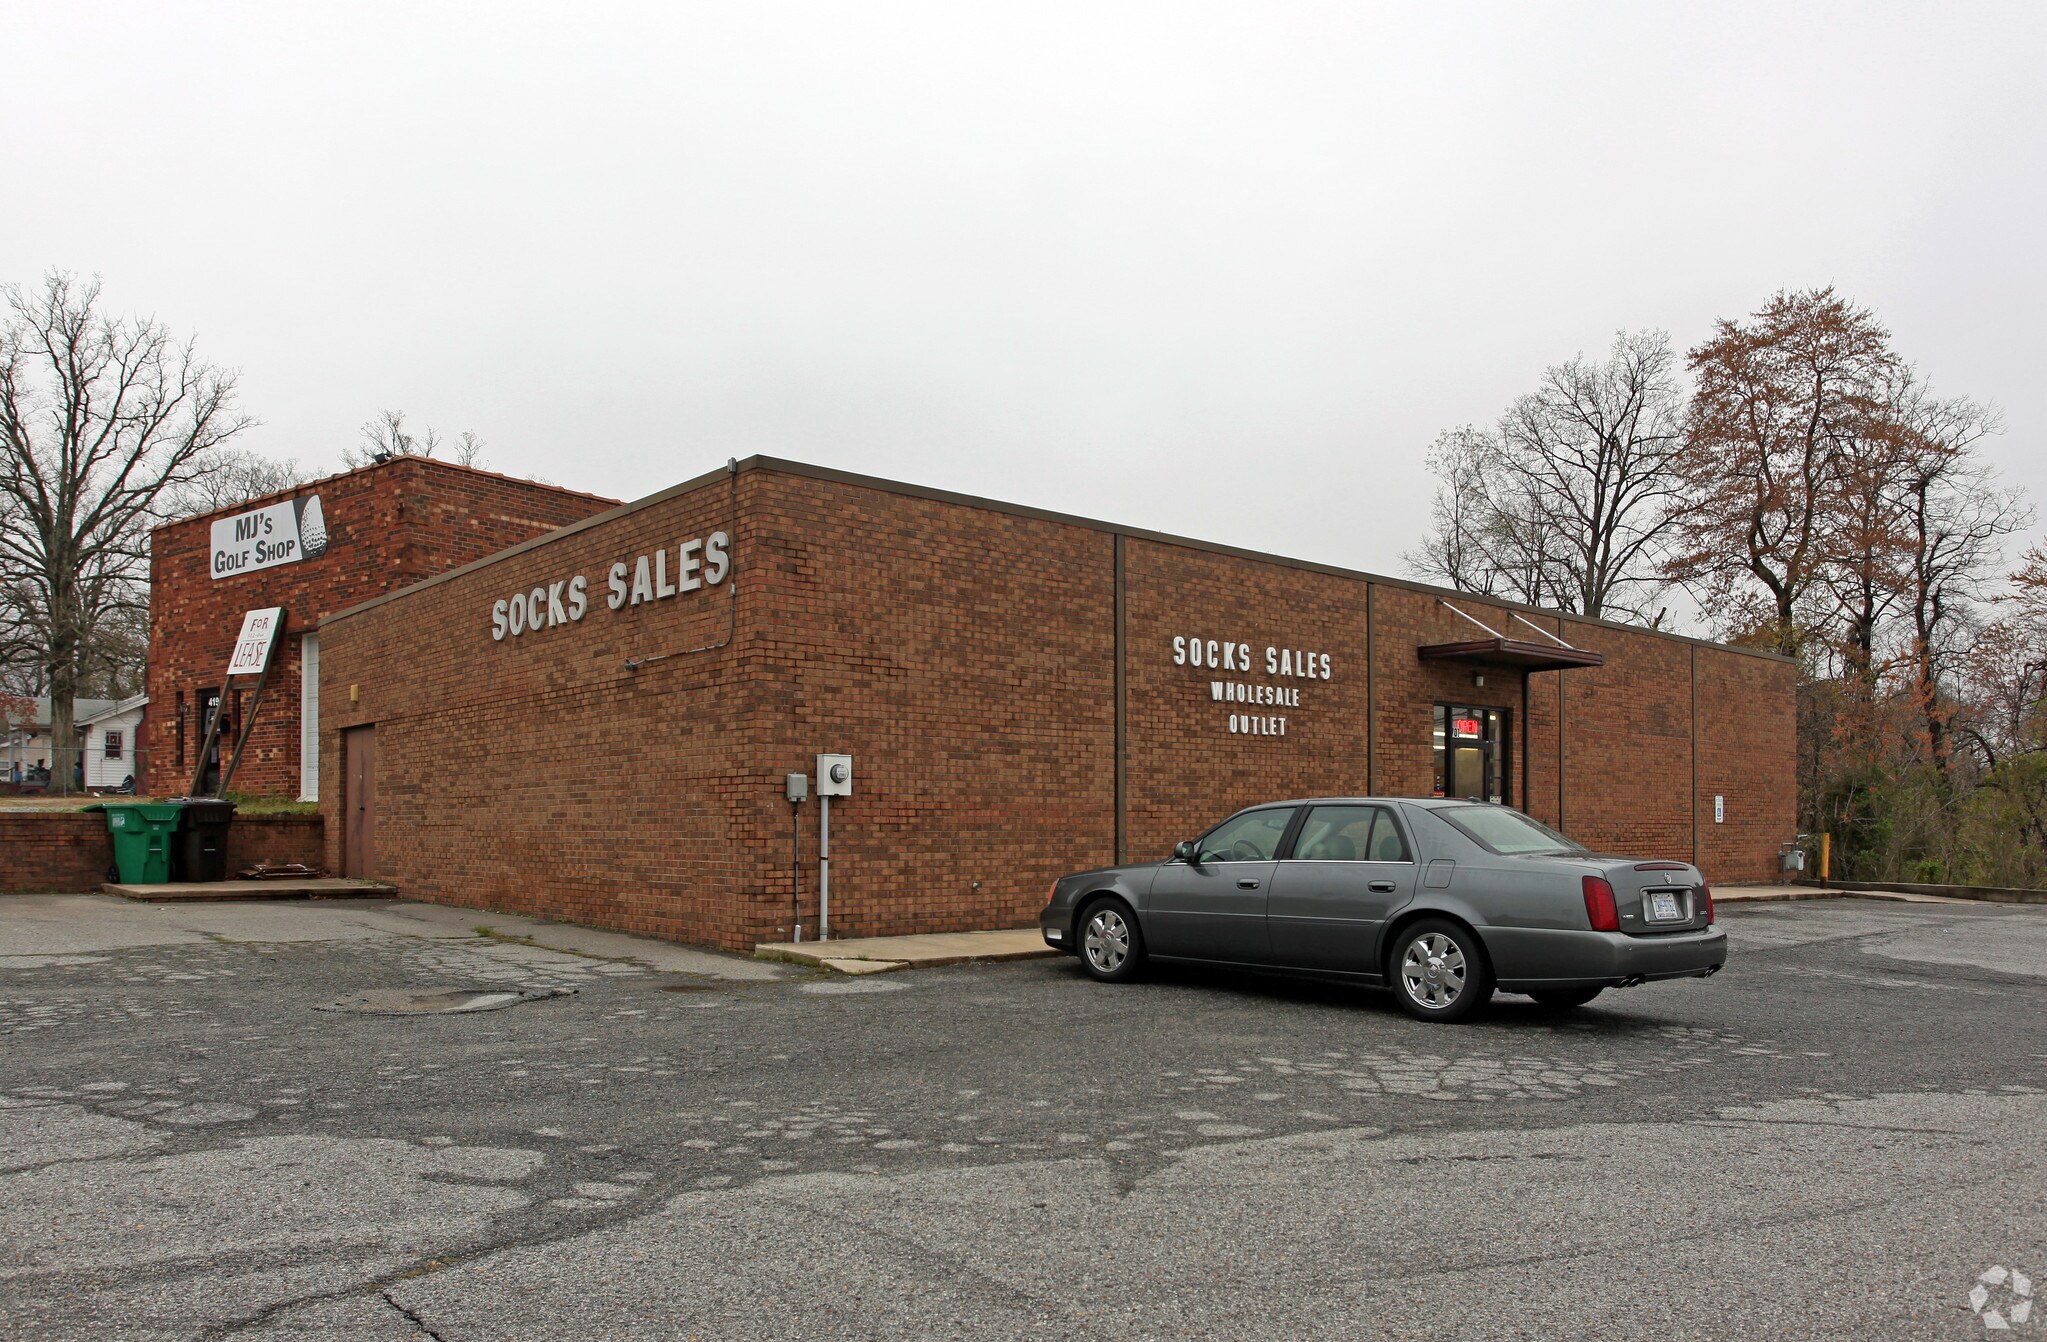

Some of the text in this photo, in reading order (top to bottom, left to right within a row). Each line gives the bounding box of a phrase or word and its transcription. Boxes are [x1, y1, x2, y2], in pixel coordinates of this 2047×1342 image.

[214, 540, 295, 573] GOLF SHOP
[492, 531, 729, 641] SOCKS SALES
[250, 617, 269, 631] FOR
[233, 641, 267, 668] LEASE
[1173, 636, 1331, 680] SOCKS SALES
[1210, 681, 1300, 707] WHOLESALE
[1229, 714, 1286, 736] OUTLET
[1456, 719, 1479, 734] OPEN
